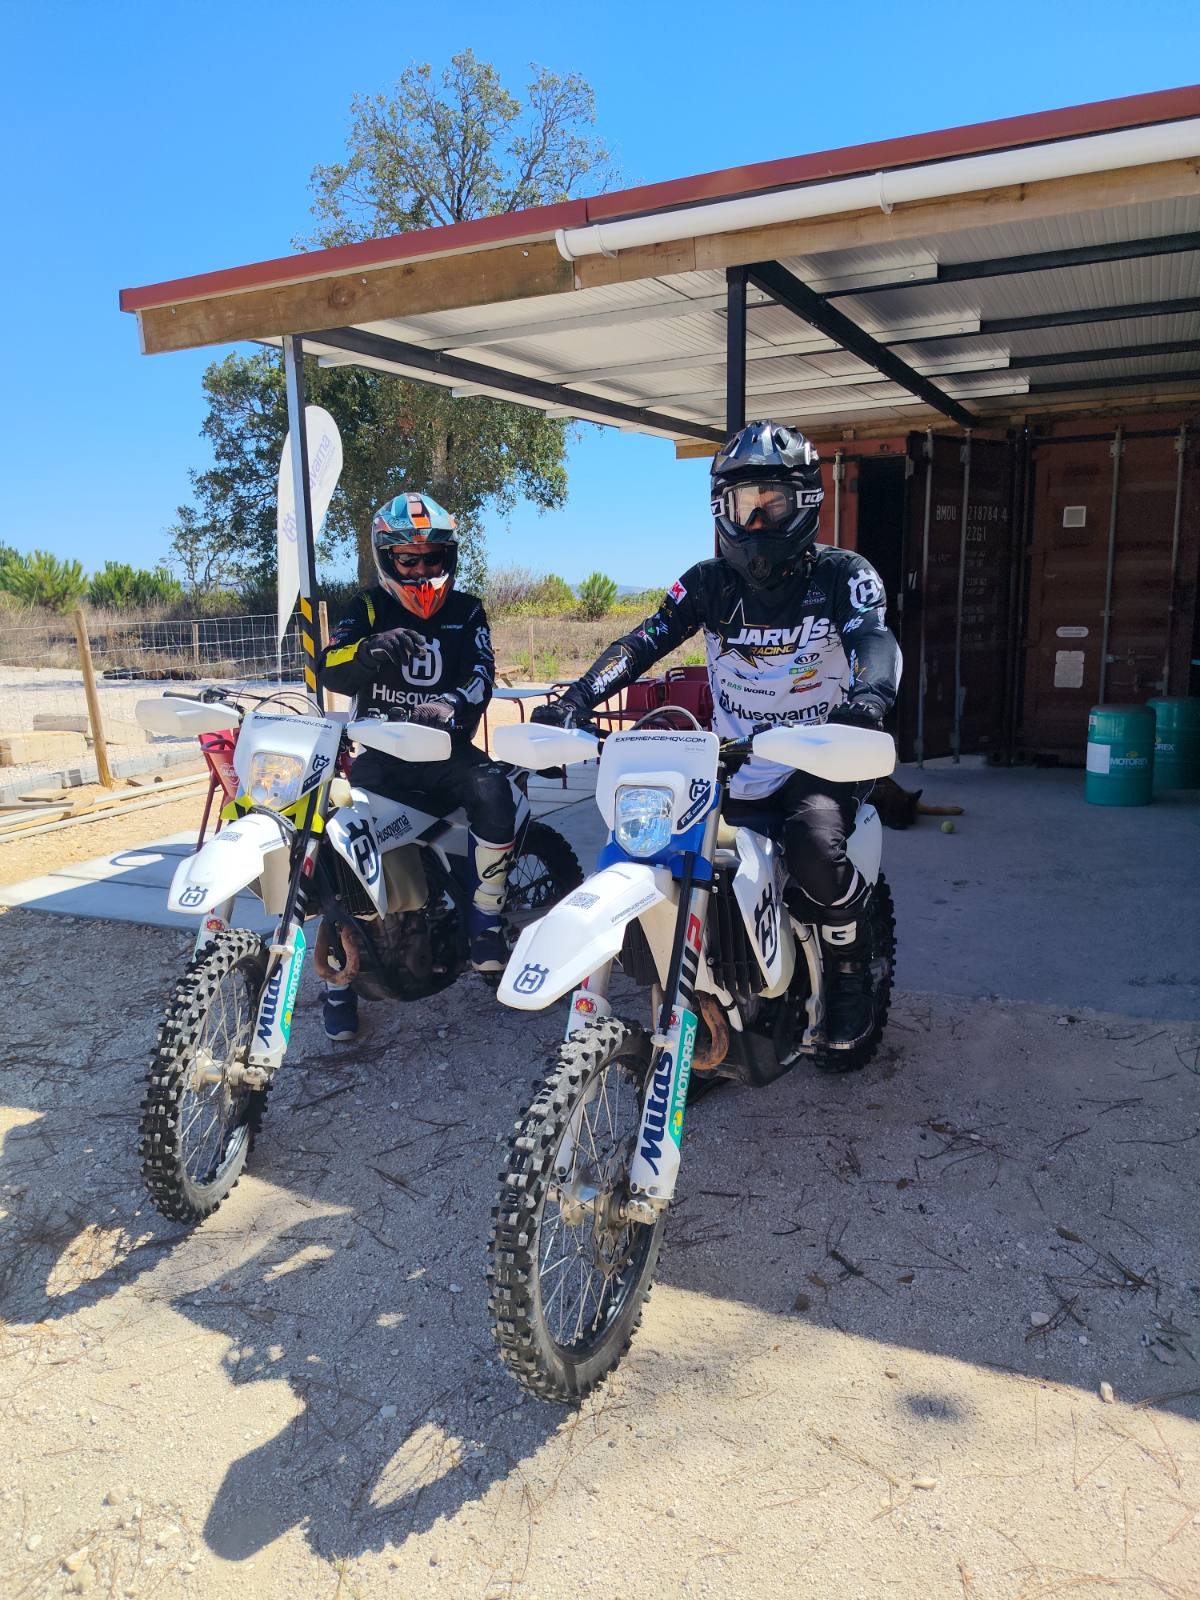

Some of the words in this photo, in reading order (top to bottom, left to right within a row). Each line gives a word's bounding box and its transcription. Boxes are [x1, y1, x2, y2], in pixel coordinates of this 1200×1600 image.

[935, 504, 957, 521] BMOU
[372, 682, 441, 706] Husqva
[743, 687, 776, 697] WORLD
[731, 701, 829, 723] Husqvarna
[674, 1022, 697, 1108] MOTOREX
[640, 1051, 673, 1177] Mitas
